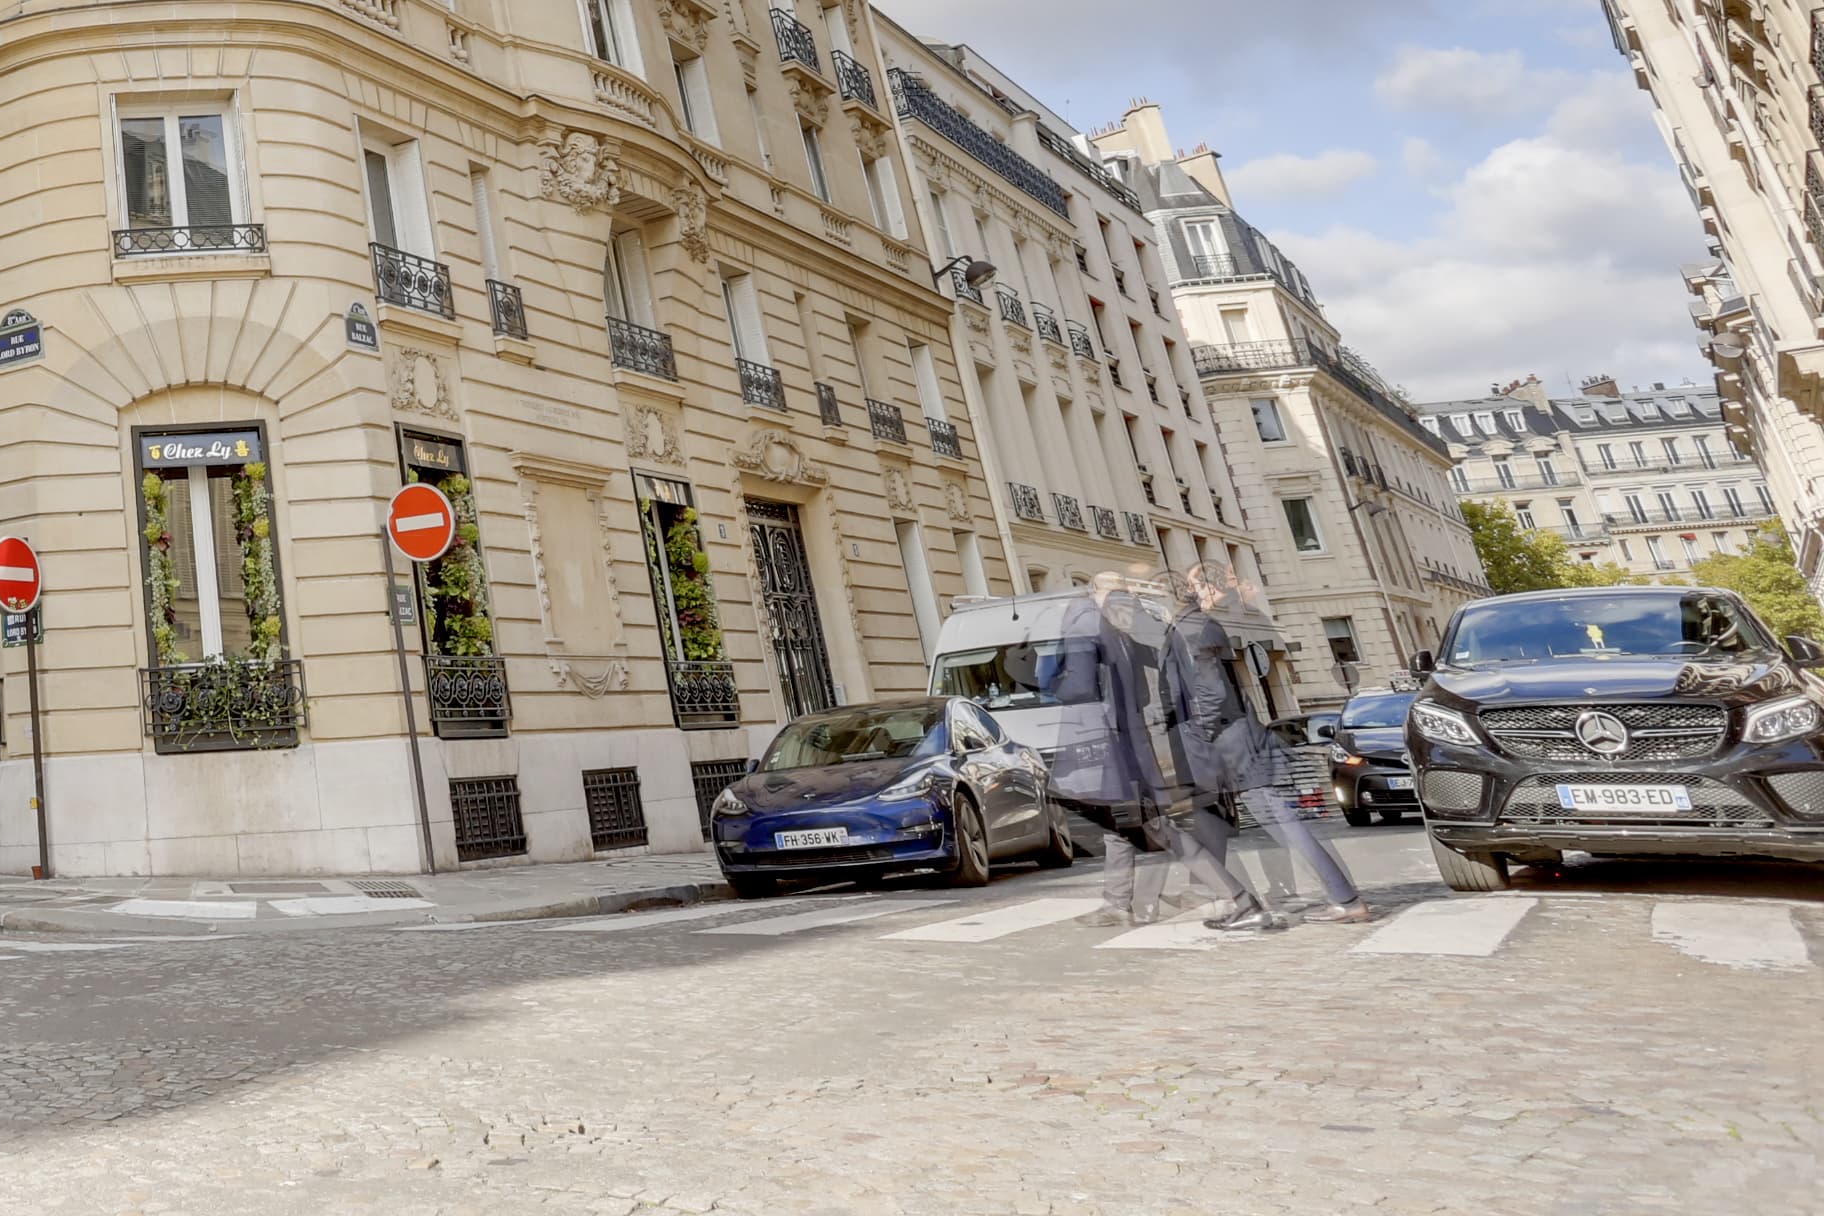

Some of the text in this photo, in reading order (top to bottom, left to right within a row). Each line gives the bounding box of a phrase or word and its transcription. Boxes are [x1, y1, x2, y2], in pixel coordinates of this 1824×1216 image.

[355, 323, 368, 333] RUE
[10, 334, 25, 345] RUE
[16, 343, 40, 356] BYRON
[162, 440, 232, 460] Chez Ly
[1571, 788, 1675, 805] EM-983-ED
